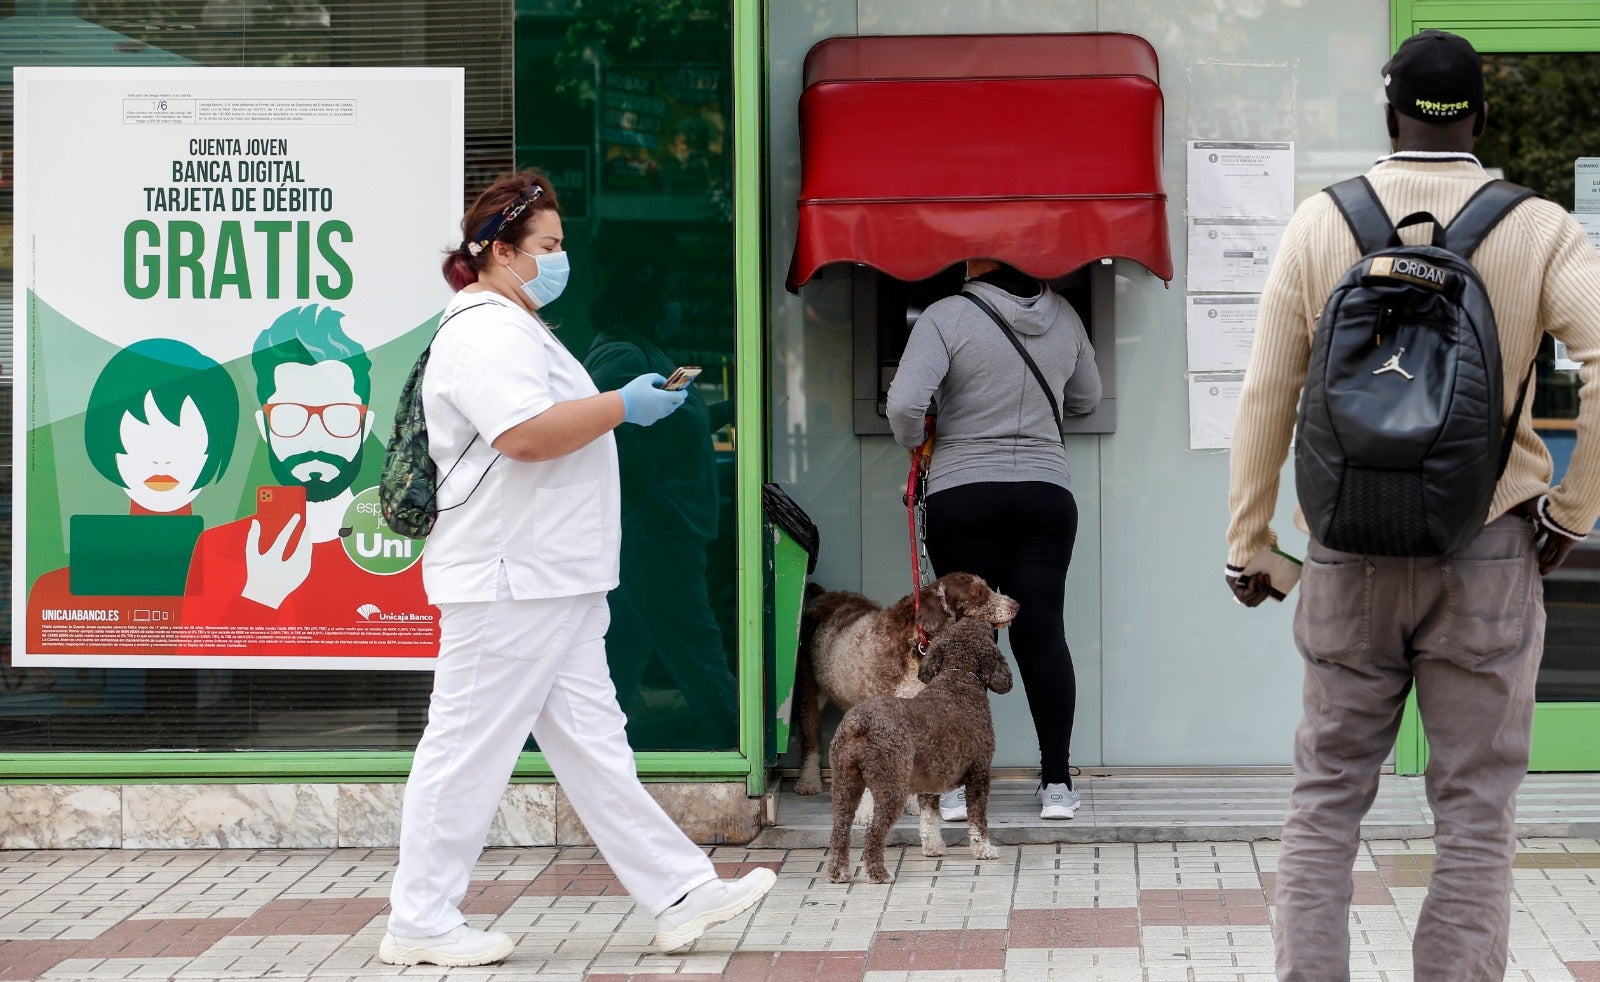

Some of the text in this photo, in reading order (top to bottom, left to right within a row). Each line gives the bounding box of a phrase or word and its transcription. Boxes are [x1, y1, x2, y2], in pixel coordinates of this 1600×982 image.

[1416, 99, 1468, 111] MONSTER
[189, 138, 288, 156] CUENTA JOVEN
[172, 160, 305, 183] BANCA DIGITAL
[143, 183, 333, 212] TARJETA DE DÉBITO
[123, 219, 353, 300] GRATIS
[1392, 259, 1446, 284] JORDAN
[41, 609, 120, 621] UNICAJABANCO.ES
[379, 612, 434, 622] Unicaja Banco
